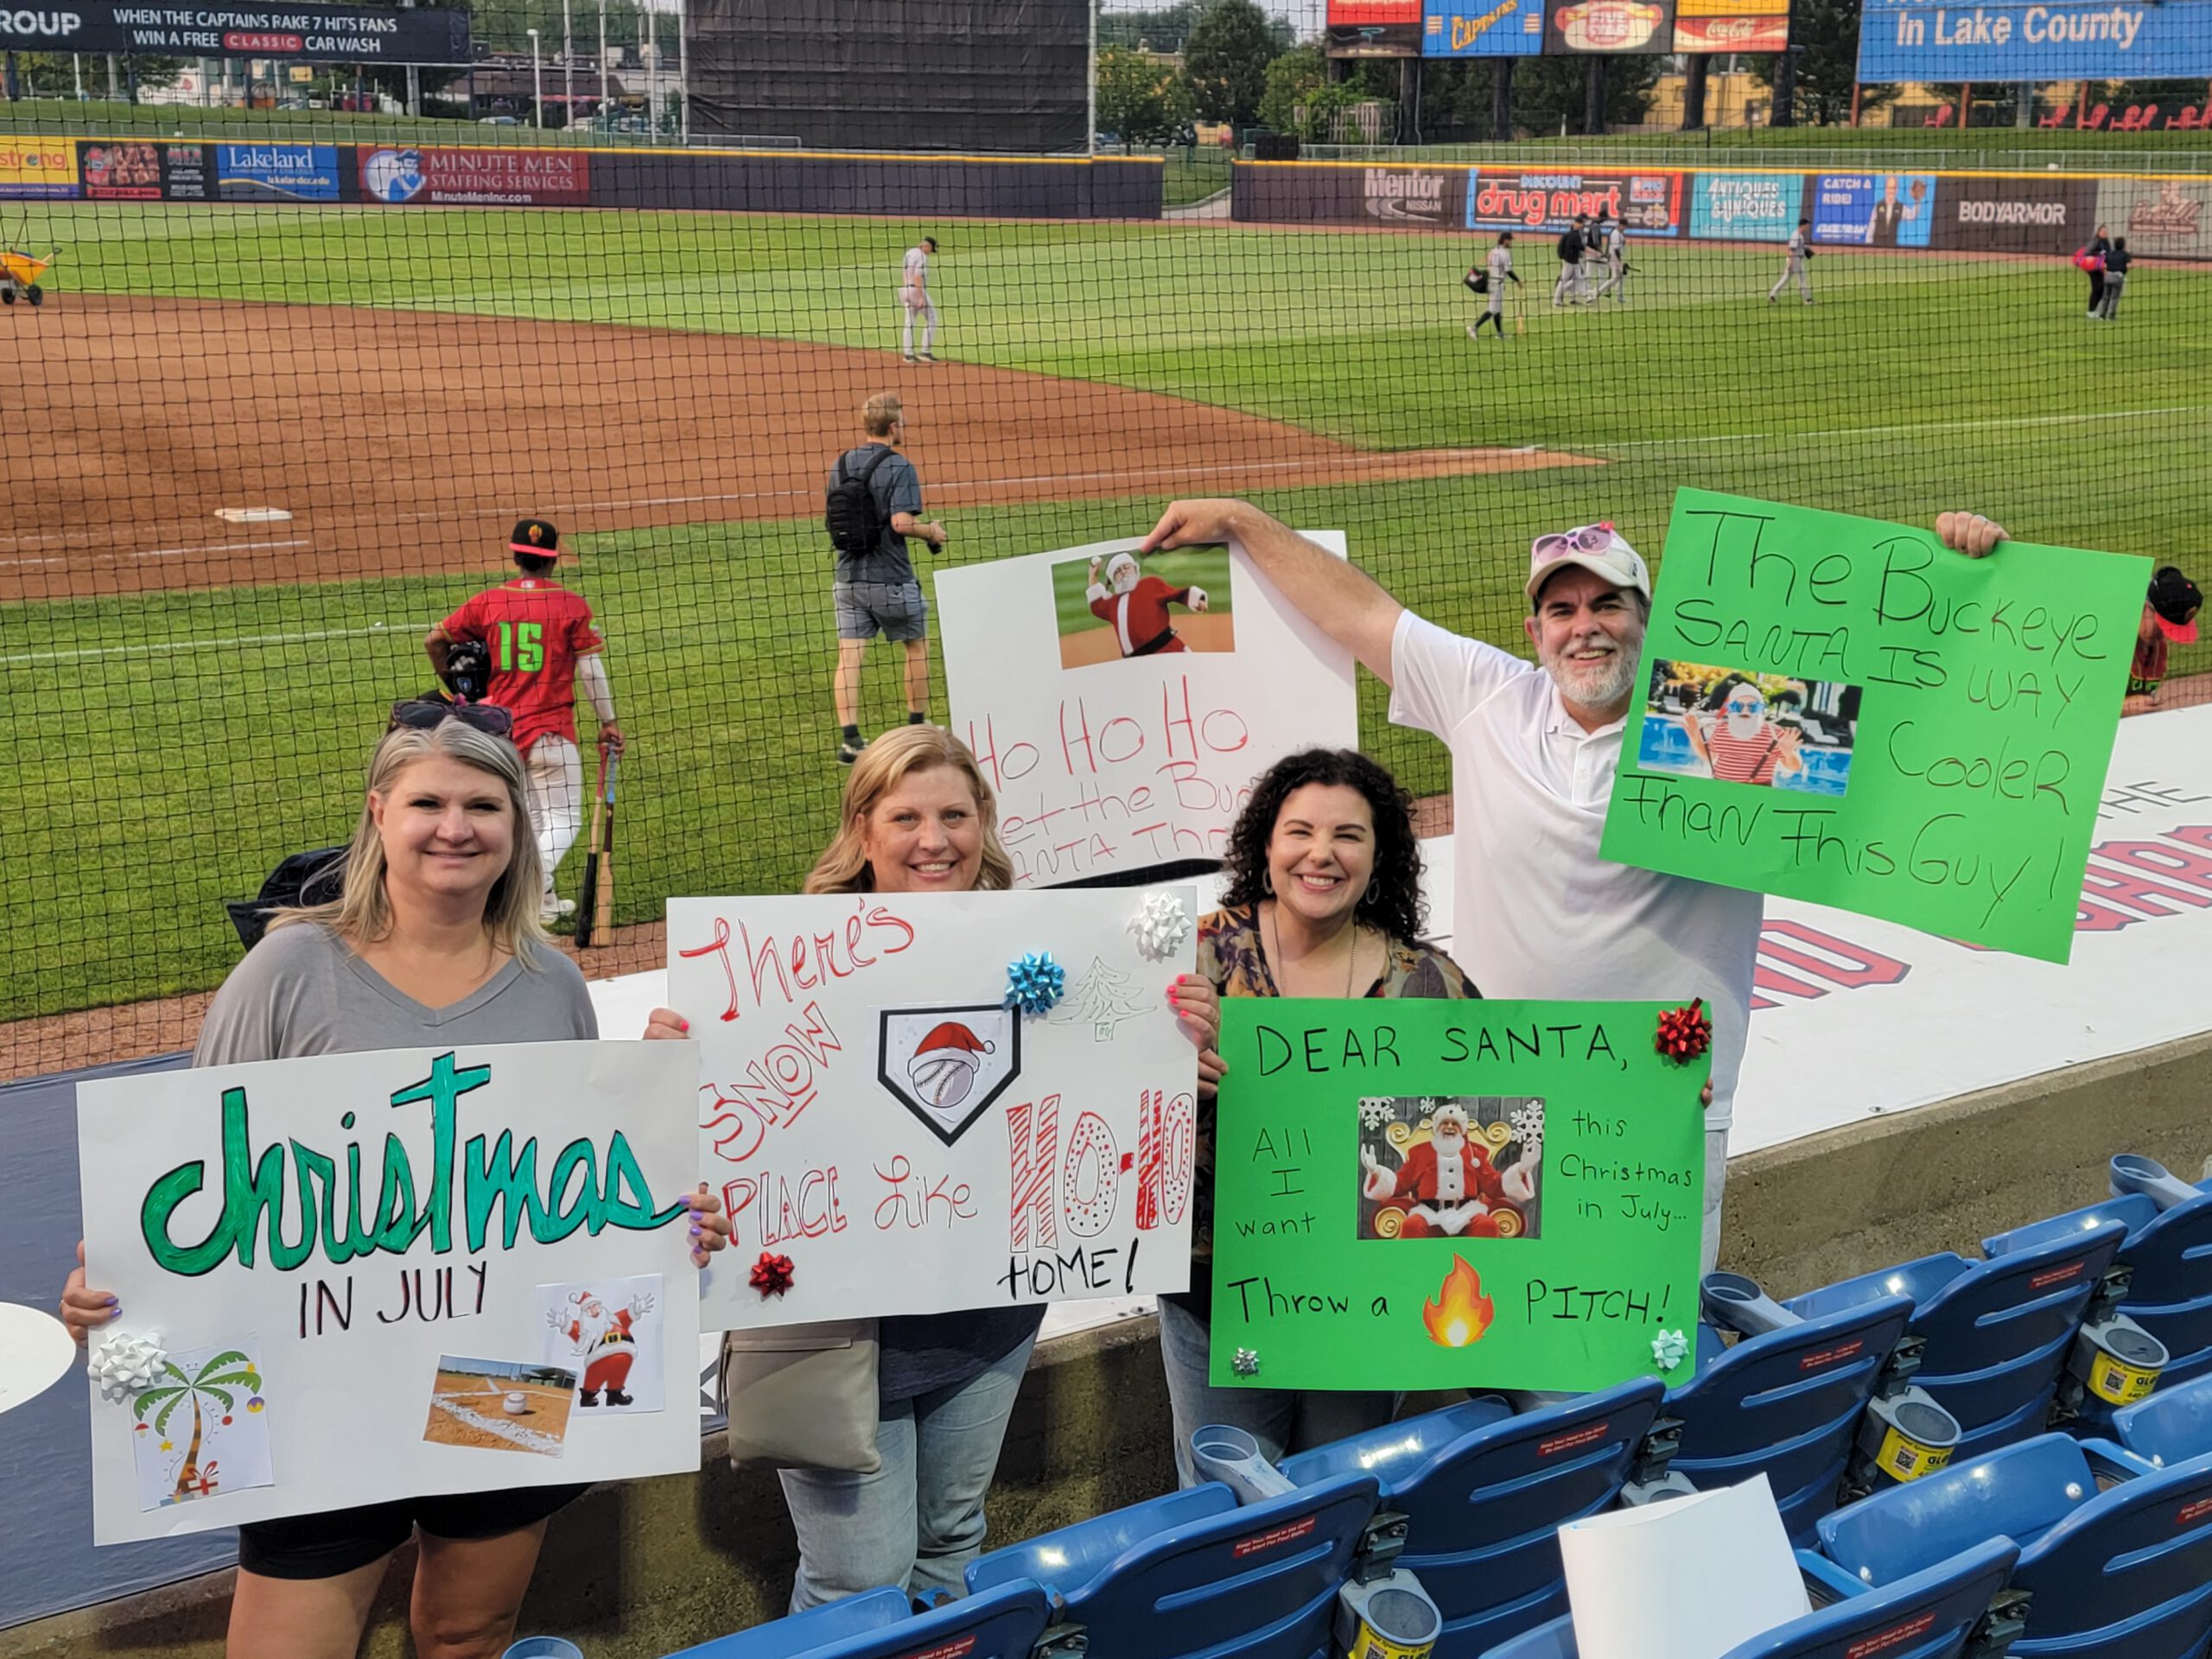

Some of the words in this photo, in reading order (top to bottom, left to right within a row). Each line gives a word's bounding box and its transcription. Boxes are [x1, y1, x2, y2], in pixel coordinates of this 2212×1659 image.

[113, 9, 162, 24] WHEN
[163, 10, 193, 25] THE
[196, 12, 269, 28] CAPTAINS
[313, 16, 321, 29] 7
[325, 16, 357, 31] HITS
[359, 18, 397, 33] FANS
[1935, 8, 2012, 46] Lake
[2023, 7, 2144, 49] County
[133, 30, 165, 45] WIN
[169, 32, 180, 45] A
[183, 32, 219, 47] FREE
[229, 35, 297, 48] CLASSIC
[305, 36, 335, 50] CAR
[336, 37, 381, 53] WASH
[228, 147, 313, 168] Lakeland
[430, 154, 518, 173] MINUTE
[524, 156, 572, 173] MEN
[431, 174, 501, 188] STAFFING
[507, 175, 573, 189] SERVICES
[1365, 168, 1444, 197] Mentor
[1521, 175, 1582, 189] DISCOUNT
[1707, 177, 1780, 200] ANTIQUES
[1824, 178, 1862, 189] CATCH
[1405, 200, 1441, 213] NISSAN
[1478, 182, 1547, 226] drug
[1550, 186, 1623, 218] mart
[1959, 201, 2066, 225] BODYARMOR
[1686, 509, 1853, 607] The
[498, 620, 544, 673] 15
[1675, 599, 1850, 678] SANTA
[1867, 646, 1948, 690] IS
[1070, 780, 1155, 823] the
[679, 896, 914, 1022] There's
[1255, 1024, 1402, 1077] DEAR
[1440, 1023, 1630, 1072] SANTA,
[699, 1001, 842, 1162] SNOW
[1571, 1109, 1628, 1139] this
[1251, 1127, 1313, 1163] All
[1006, 1089, 1195, 1253] HO-HO
[1270, 1166, 1305, 1198] I
[1560, 1153, 1694, 1189] Christmas
[1234, 1211, 1318, 1237] want
[1577, 1196, 1604, 1222] in
[299, 1275, 354, 1340] IN
[376, 1260, 489, 1326] JULY
[1226, 1275, 1350, 1324] Throw
[1370, 1293, 1391, 1319] a
[1526, 1278, 1672, 1326] PITCH!
